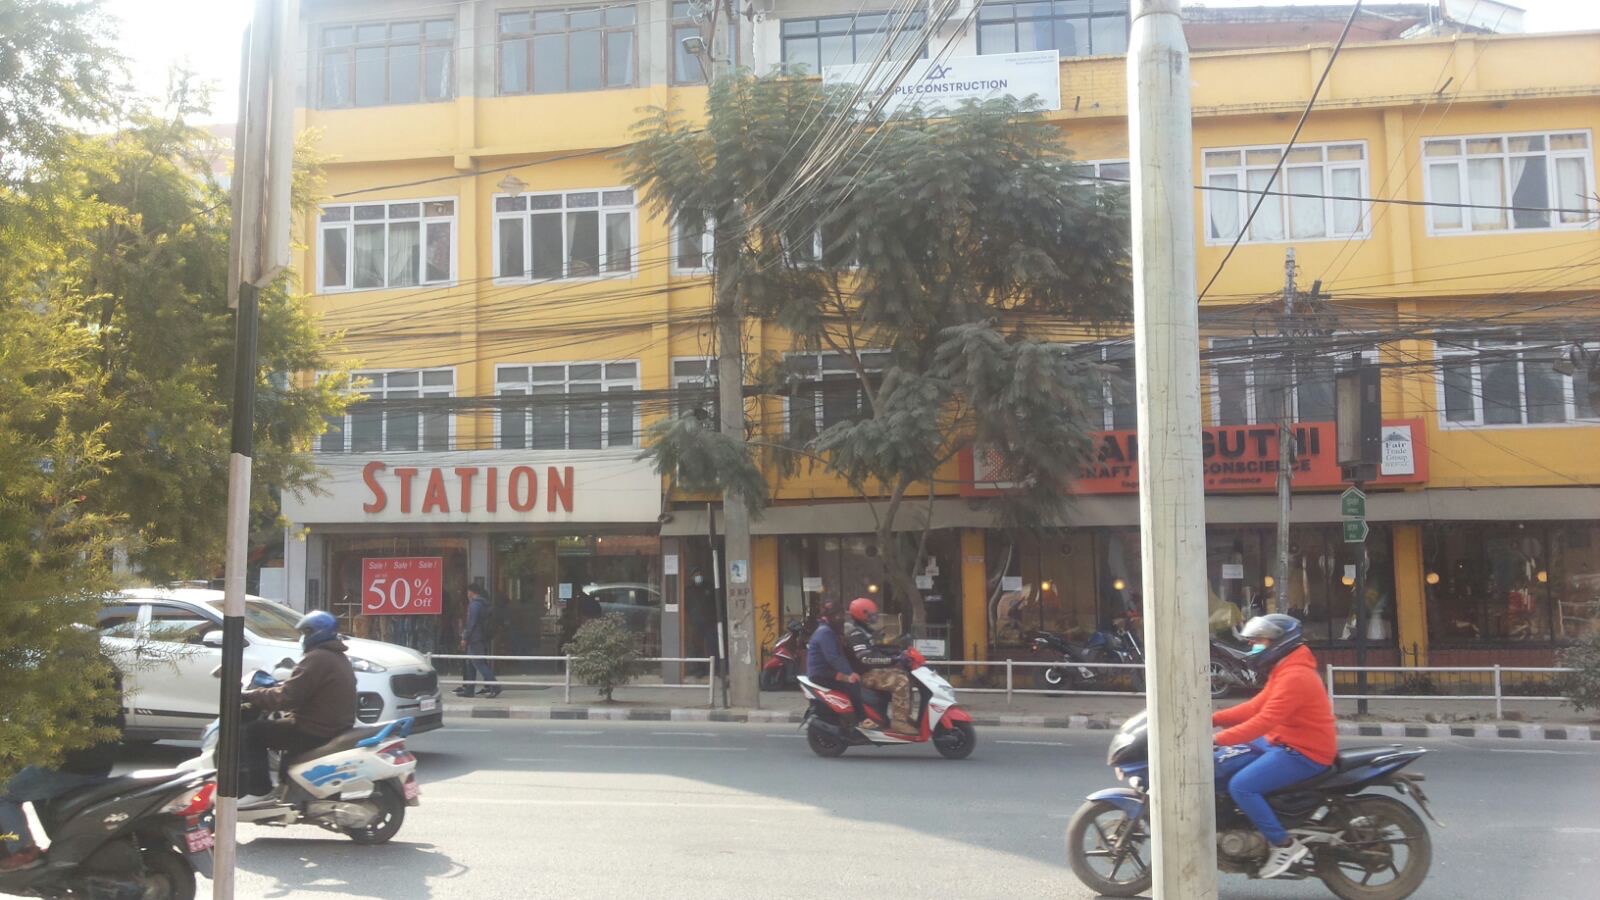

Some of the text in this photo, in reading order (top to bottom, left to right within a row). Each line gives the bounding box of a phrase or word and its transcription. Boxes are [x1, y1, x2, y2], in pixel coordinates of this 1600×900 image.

[873, 84, 914, 97] APLE
[916, 79, 1008, 94] CONSTRUCTION
[1074, 459, 1311, 478] RAFT ONSCIEE
[363, 461, 574, 513] STATION
[414, 598, 432, 607] Off
